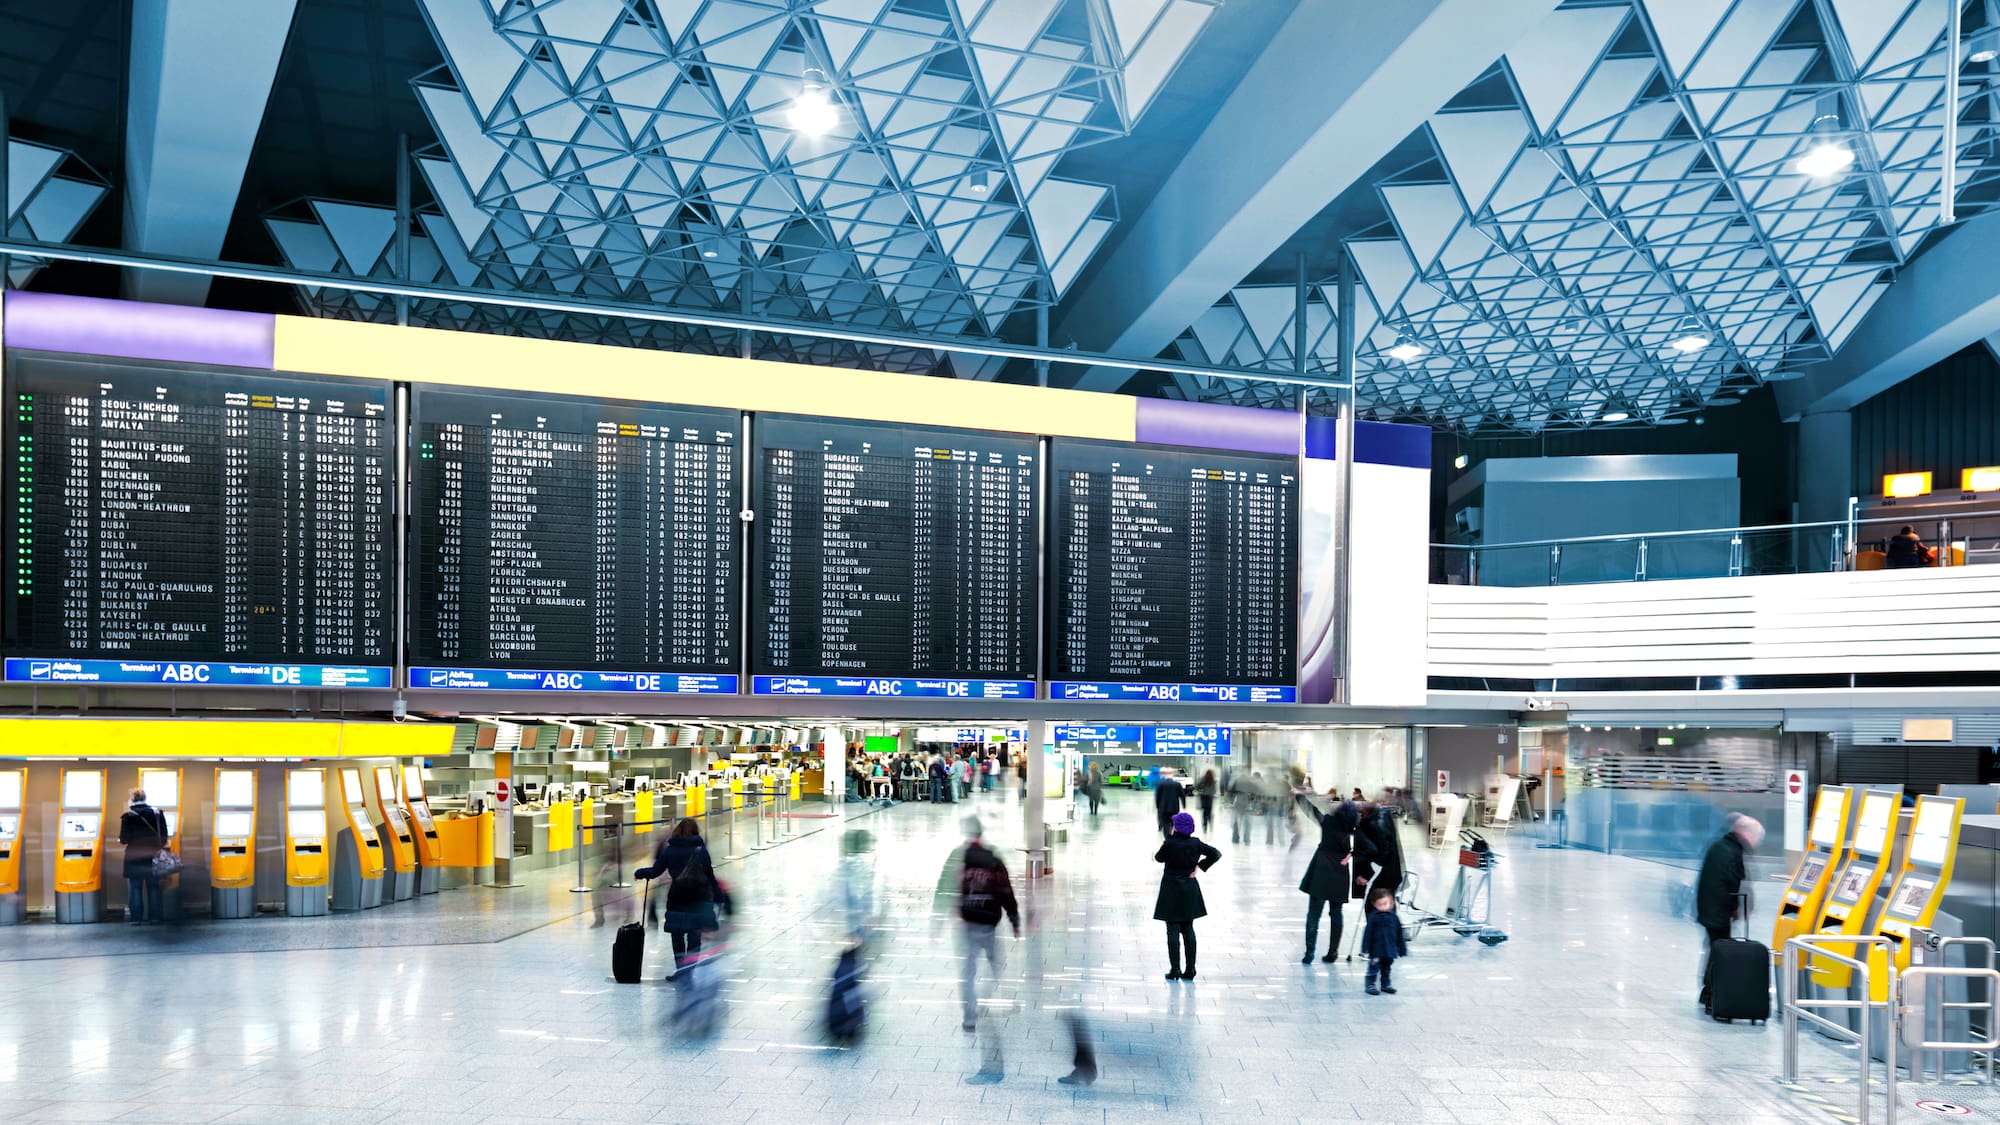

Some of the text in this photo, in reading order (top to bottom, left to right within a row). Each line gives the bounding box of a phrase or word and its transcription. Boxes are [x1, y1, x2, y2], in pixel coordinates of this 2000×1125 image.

[102, 400, 179, 412] SEOUL-INCHEON
[64, 407, 89, 417] 6798
[71, 417, 88, 426] 554
[101, 420, 143, 430] ANTALYA
[101, 440, 184, 452] MAURITIUS-GENF
[71, 448, 88, 457] 936
[102, 450, 190, 462] SHANGHAI PUDONG
[492, 448, 552, 458] JOHANNESBURG
[522, 459, 552, 467] NARITA
[824, 454, 858, 463] BUDAPEST
[101, 460, 129, 469] KABUL
[71, 468, 88, 477] 982
[824, 471, 854, 480] BOLOGNA
[492, 476, 527, 484] ZUERICH
[824, 480, 854, 488] BELGRAD
[101, 481, 161, 491] KOPENHAGEN
[491, 485, 537, 494] NUERNBERG
[101, 491, 131, 499] KOELN
[824, 488, 850, 496] MADRID
[64, 499, 88, 507] 4742
[492, 494, 526, 503] HAMBURG
[824, 497, 889, 507] LONDON-HEATHROW
[102, 501, 190, 512] LONDON-HEATHROW
[72, 509, 88, 518] 126
[101, 511, 124, 519] WIEN
[491, 513, 531, 521] HANNOVER
[101, 521, 129, 529] DUBAI
[491, 522, 526, 530] BANGKOK
[64, 529, 88, 537] 4758
[101, 531, 124, 539] OSLO
[101, 541, 136, 549] DUBLIN
[491, 541, 531, 549] WARSCHAU
[824, 540, 866, 549] MANCHESTER
[64, 549, 88, 558] 5302
[491, 550, 536, 558] AMSTERDAM
[101, 561, 147, 570] BUDAPEST
[491, 559, 541, 568] HOF-PLAUEN
[64, 580, 87, 588] 8071
[125, 582, 212, 592] PAULO-GUARULHOS
[491, 578, 566, 587] FRIEDRICHSHAFEN
[137, 592, 171, 600] NARITA
[491, 587, 560, 596] MAILAND-LINATE
[823, 592, 870, 600] PARIS-CH.DE
[101, 601, 147, 610] BUKAREST
[490, 596, 585, 606] MUENSTER OSNABRUECK
[101, 611, 140, 619] KAYSERI
[64, 620, 87, 628] 4234
[101, 622, 164, 630] PARIS-CH.DE
[101, 632, 188, 641] LONDON-HEATHROW
[53, 662, 81, 671] Abflug
[53, 672, 99, 680] Departures
[120, 663, 155, 672] Terminal
[162, 664, 210, 682] ABC
[229, 666, 263, 674] Terminal
[272, 667, 301, 684] DE
[542, 673, 583, 689] ABC
[636, 675, 660, 690] DE
[867, 680, 902, 695] ABC
[947, 682, 968, 696] DE
[1148, 686, 1178, 699] ABC
[1219, 687, 1237, 700] DE
[1106, 728, 1116, 739] C
[1195, 729, 1217, 740] A,B
[1195, 742, 1216, 754] D,E
